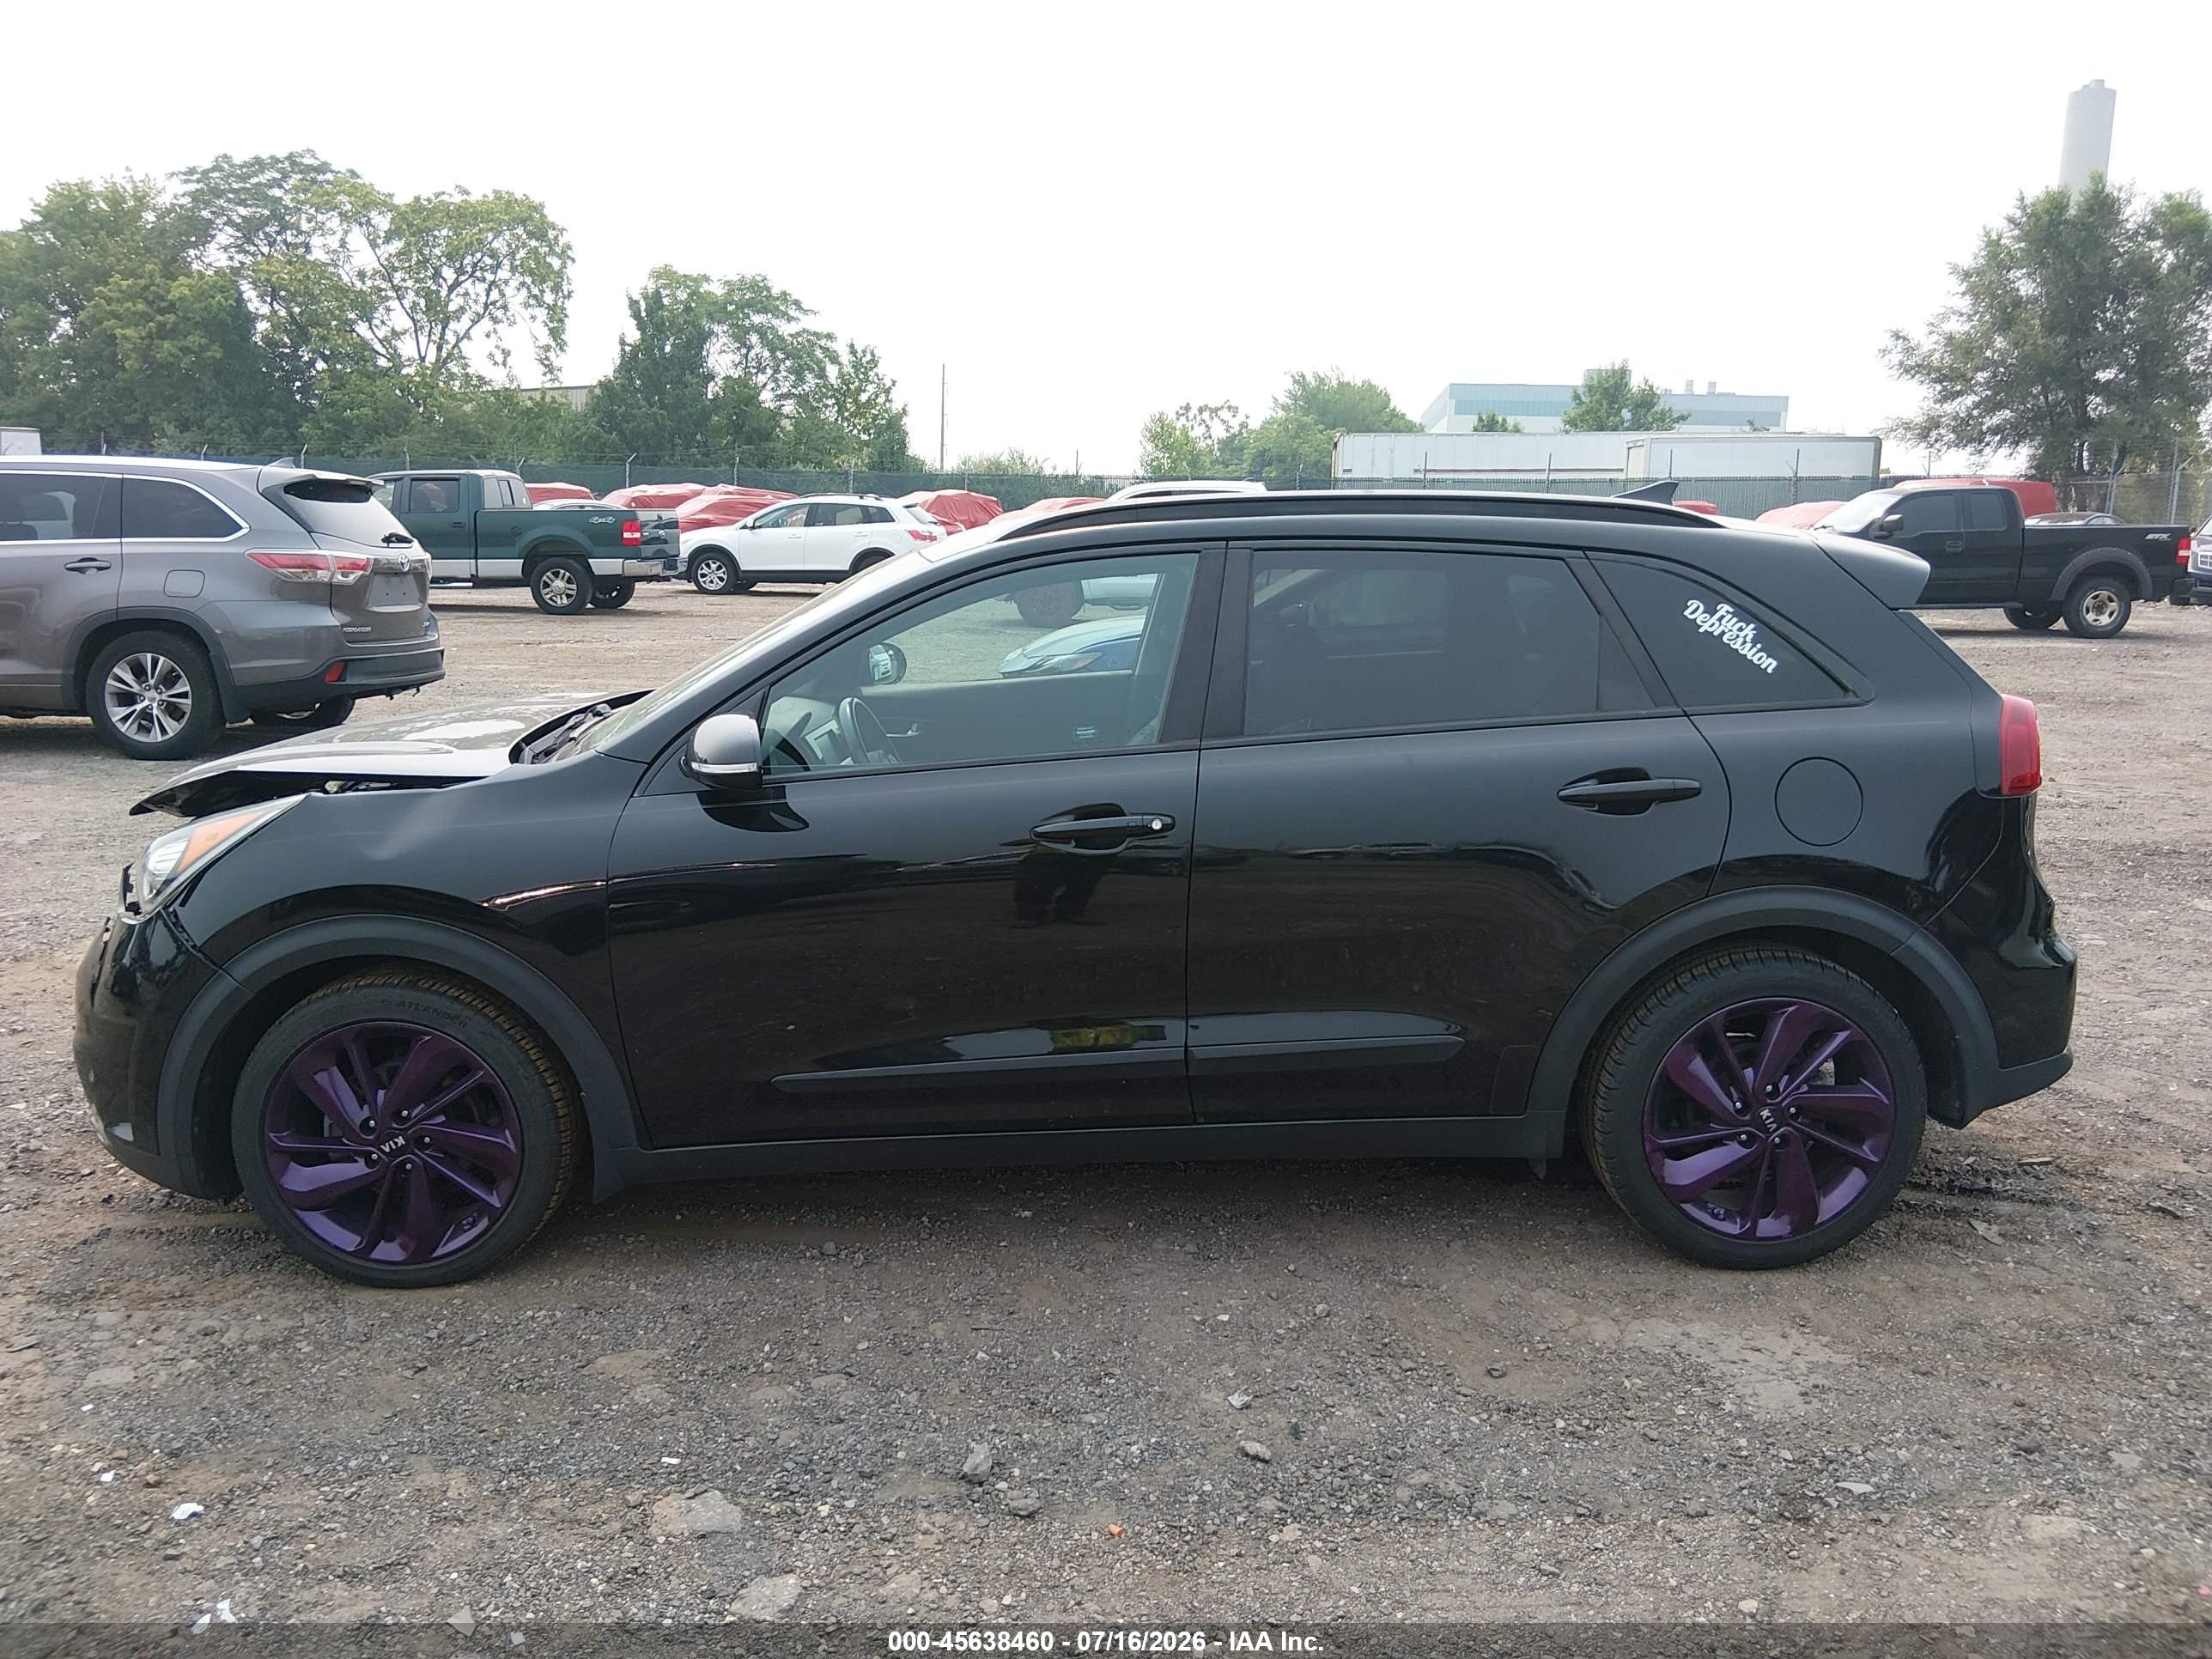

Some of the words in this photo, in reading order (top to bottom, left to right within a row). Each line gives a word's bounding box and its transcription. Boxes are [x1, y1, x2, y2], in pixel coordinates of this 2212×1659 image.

[1682, 599, 1778, 674] Depression
[1715, 603, 1758, 642] Fuck
[1759, 1109, 1778, 1133] KIA
[380, 1135, 406, 1152] KIA
